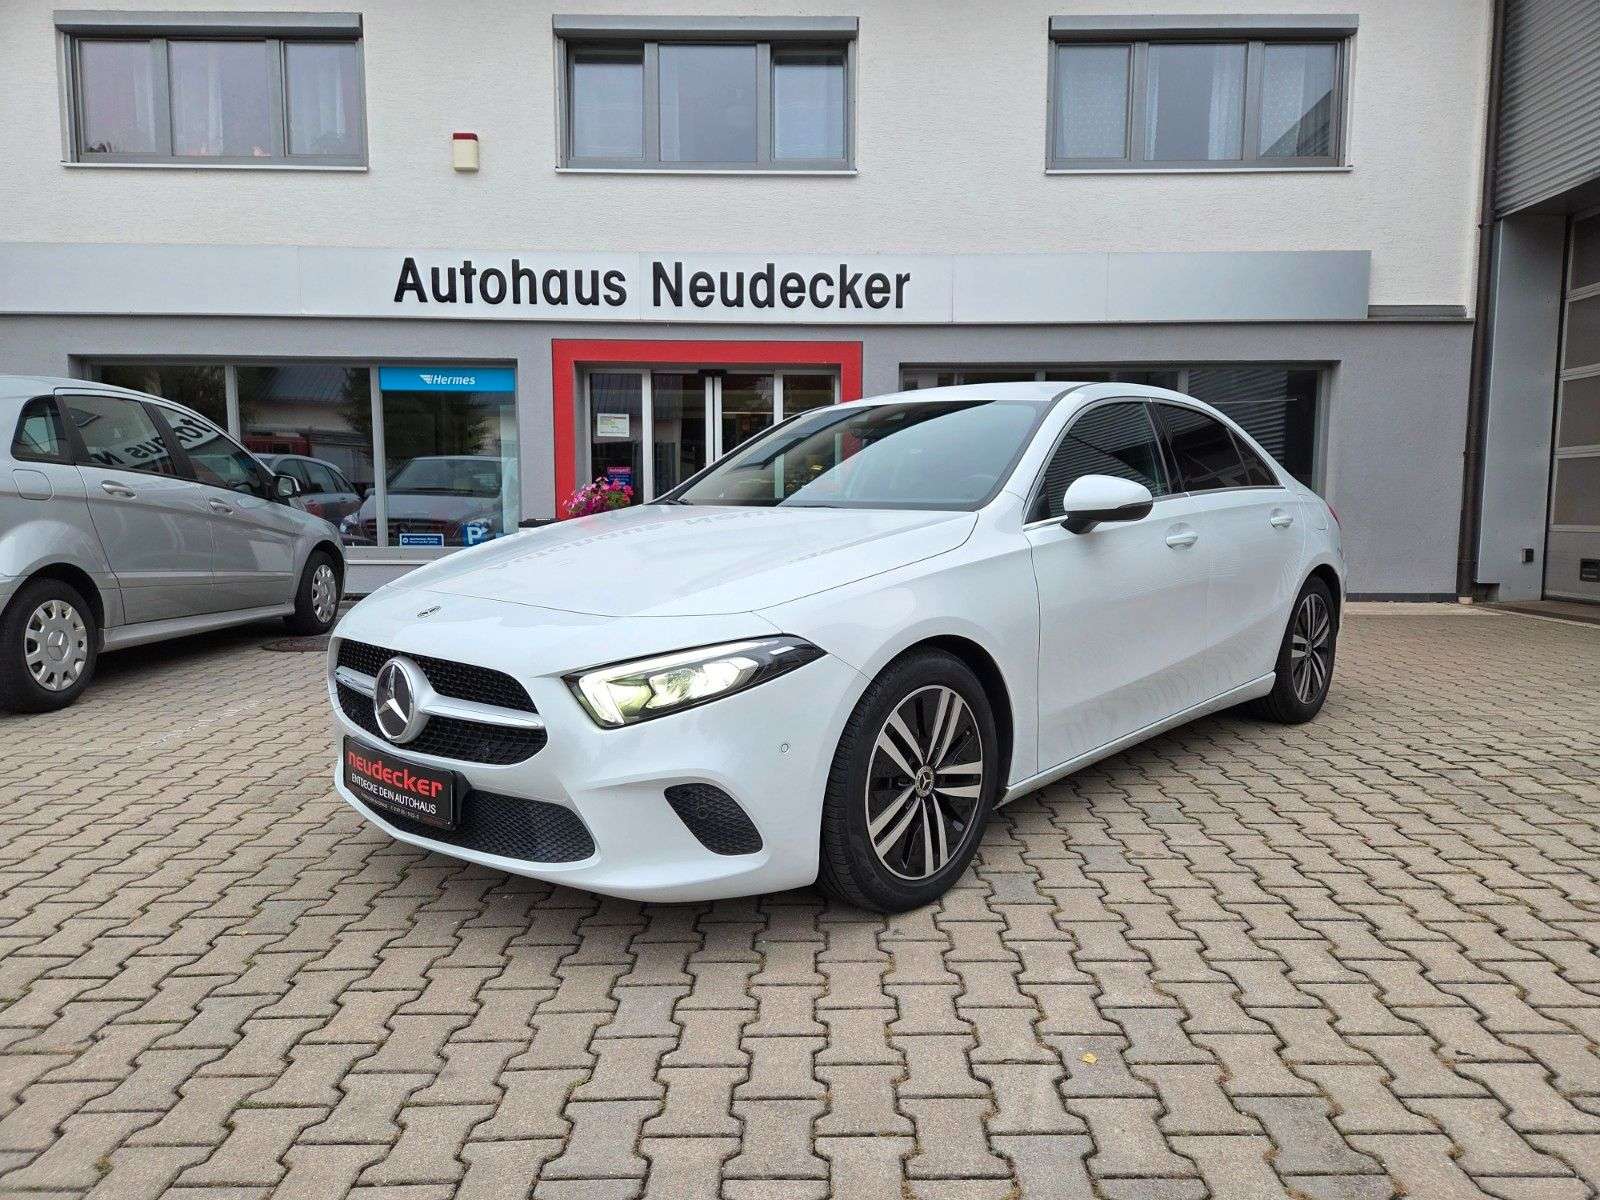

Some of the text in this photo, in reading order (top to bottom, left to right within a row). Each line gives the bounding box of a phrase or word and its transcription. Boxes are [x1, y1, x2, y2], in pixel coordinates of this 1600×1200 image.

[393, 256, 911, 309] Autohaus Neudecker
[432, 374, 476, 385] Hermes
[347, 751, 443, 798] neudecker
[351, 773, 378, 794] ENTDECKE
[379, 786, 394, 801] DEIN
[395, 793, 437, 814] AUTOHAUS
